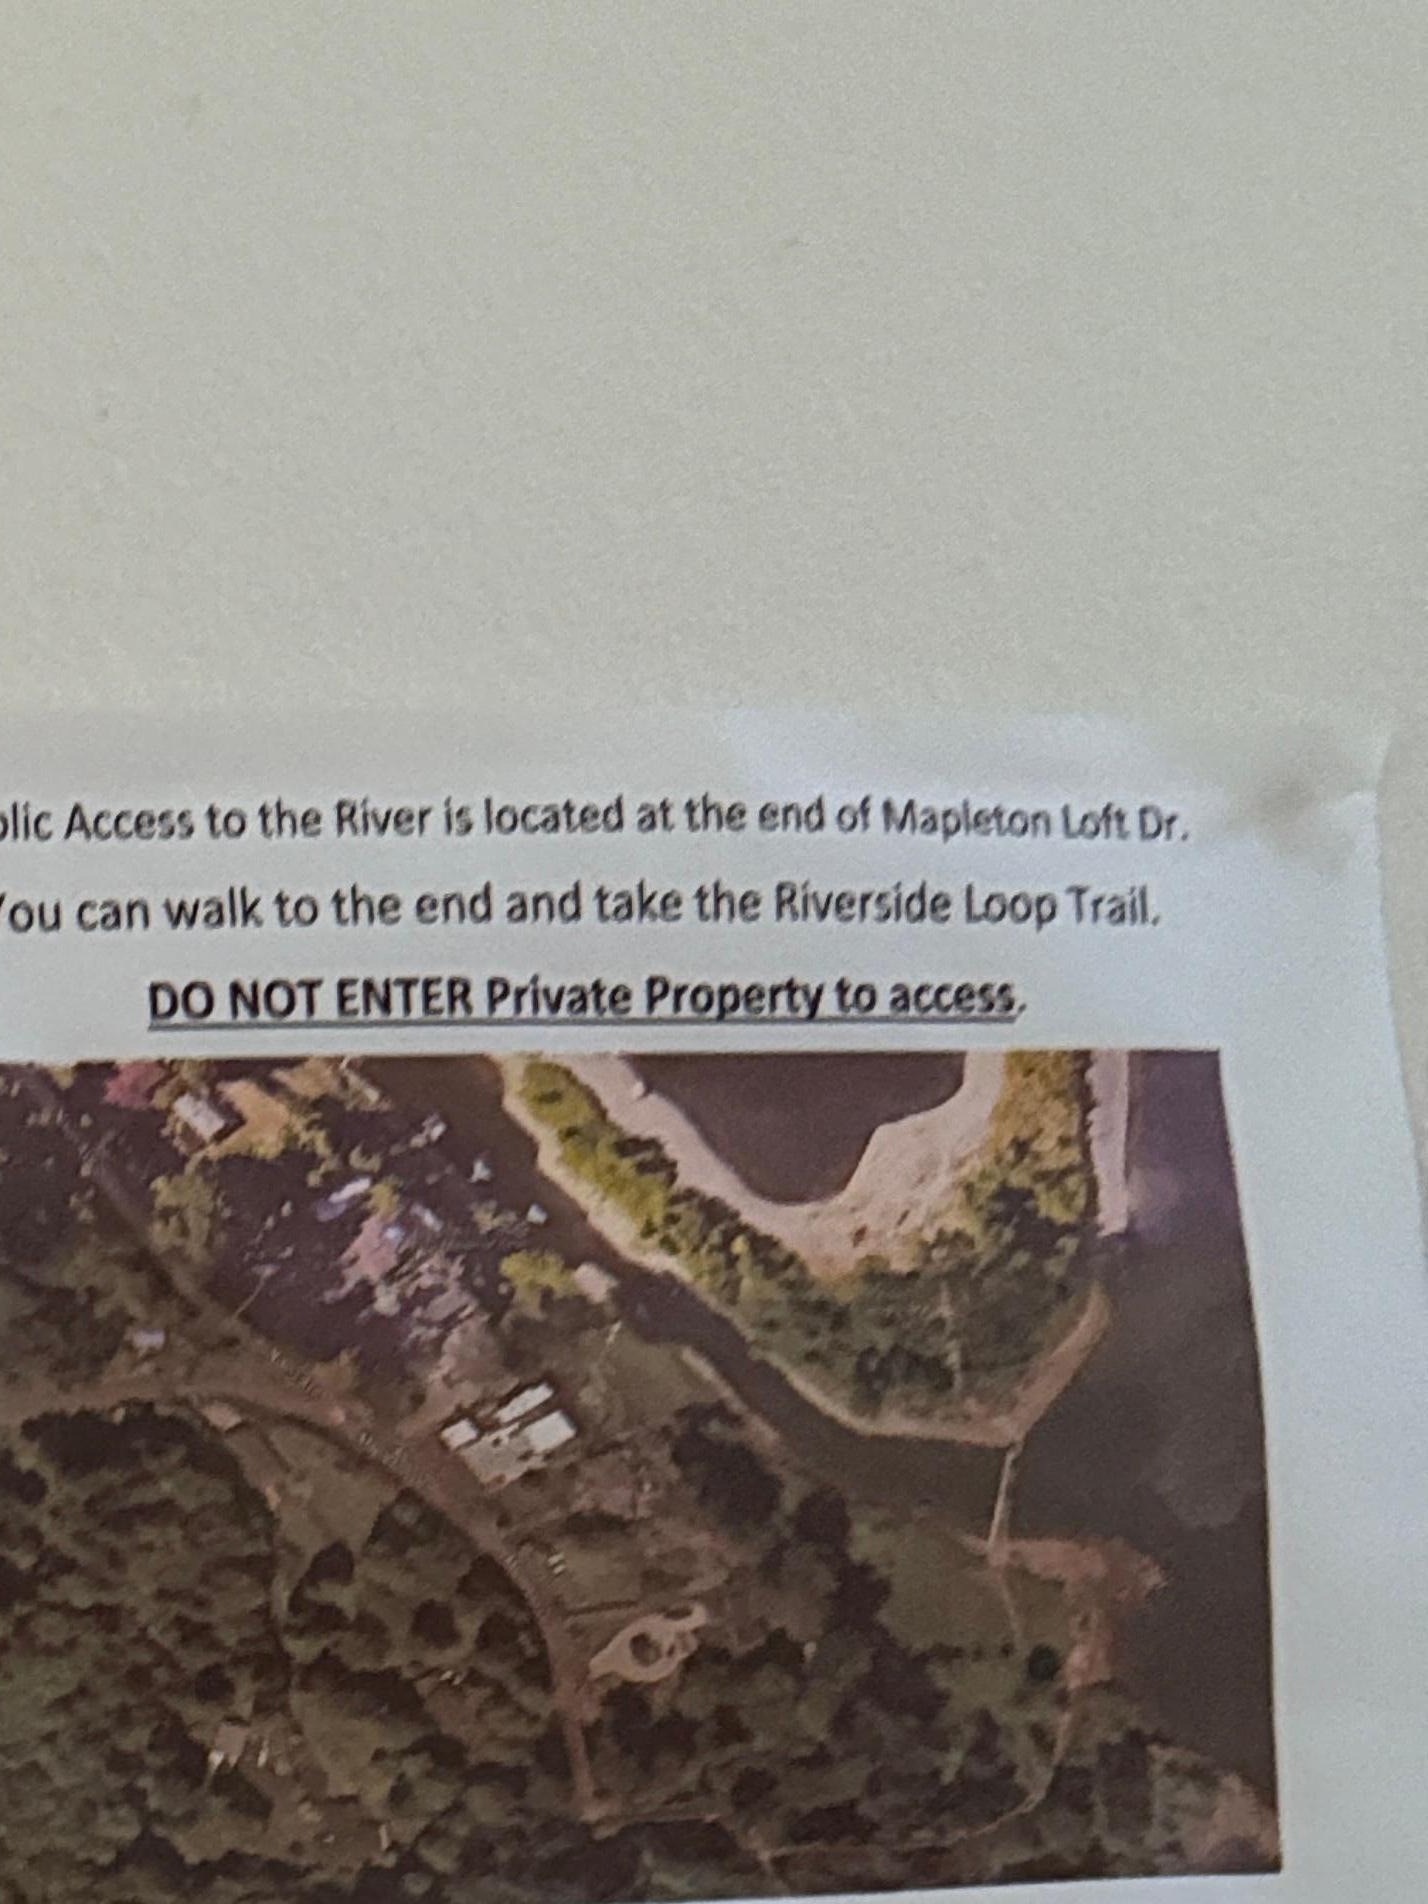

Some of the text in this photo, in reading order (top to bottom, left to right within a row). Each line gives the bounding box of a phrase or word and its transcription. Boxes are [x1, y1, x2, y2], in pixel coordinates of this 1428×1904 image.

[64, 801, 195, 841] Access
[207, 803, 246, 839] to
[258, 797, 322, 837] the
[337, 796, 432, 837] River
[445, 796, 474, 836] is
[485, 795, 624, 836] located
[636, 796, 675, 834] at
[685, 792, 746, 833] the
[758, 794, 826, 832] end
[836, 795, 871, 833] of
[882, 797, 1053, 844] Mapleton
[1061, 803, 1132, 840] Loft
[1139, 808, 1190, 843] Dr.
[75, 898, 151, 931] can
[163, 884, 265, 929] walk
[274, 892, 319, 927] to
[331, 882, 402, 925] the
[415, 881, 493, 925] end
[505, 879, 582, 923] and
[594, 879, 682, 924] take
[693, 878, 762, 924] the
[774, 878, 953, 925] Riverside
[964, 882, 1059, 934] Loop
[1065, 884, 1162, 928] Trail.
[148, 979, 215, 1022] DO
[229, 977, 324, 1021] NOT
[335, 976, 475, 1019] ENTER
[485, 973, 633, 1017] Private
[645, 974, 826, 1021] Property
[834, 975, 879, 1016] to
